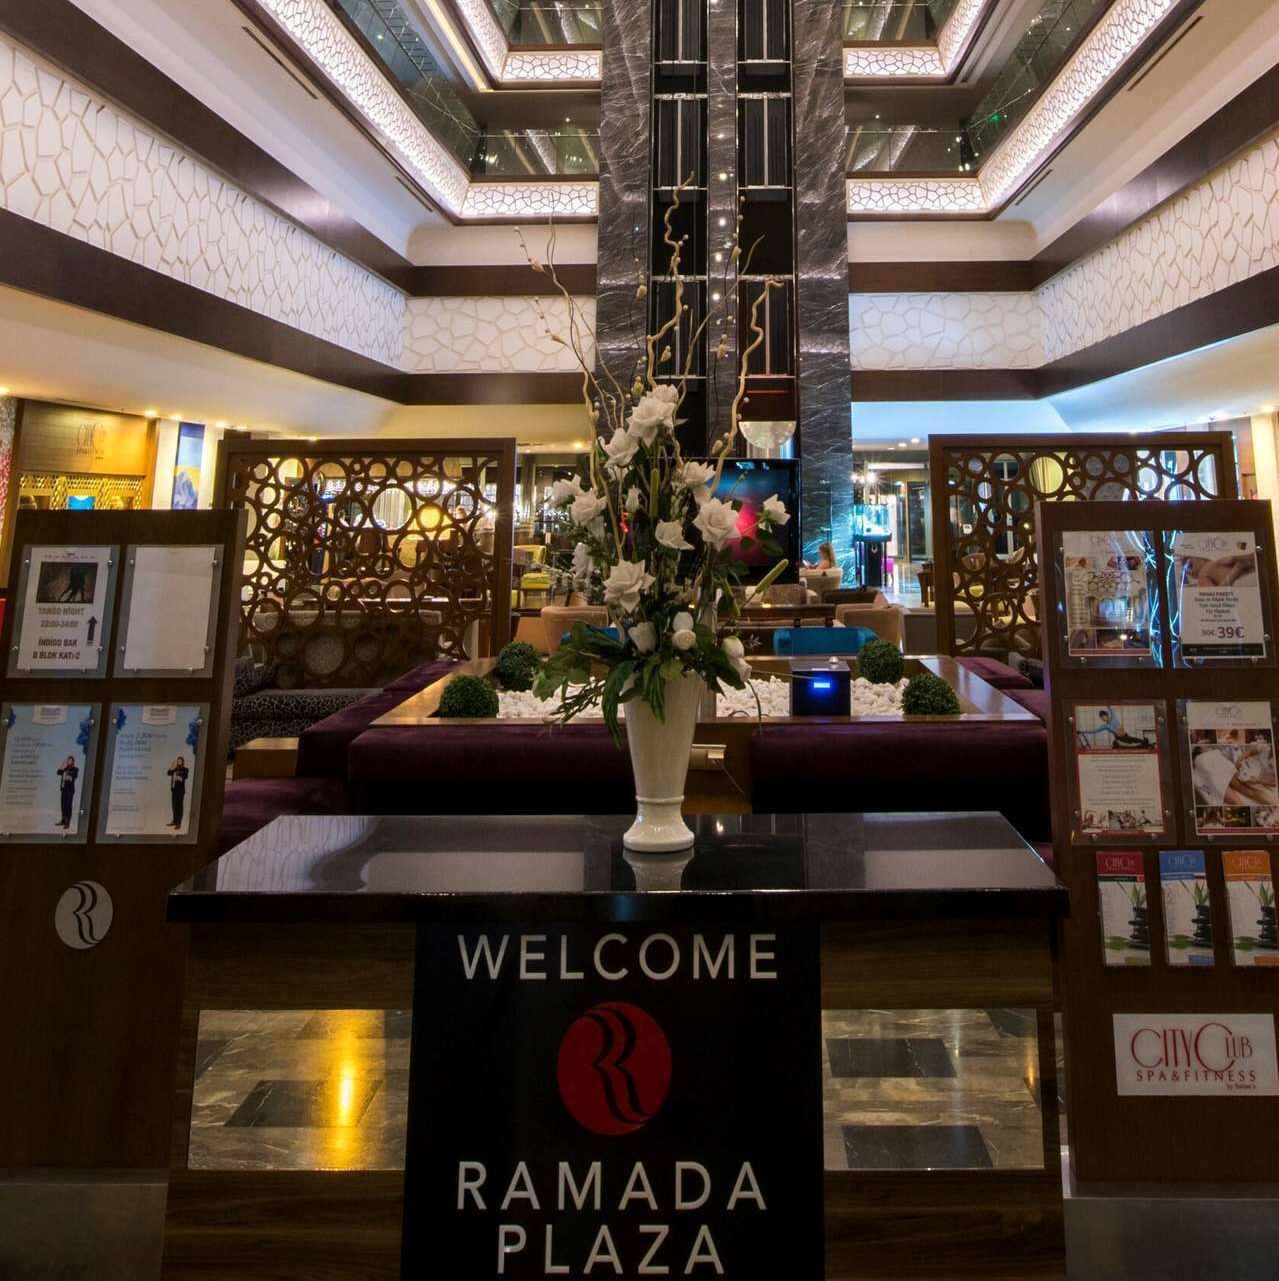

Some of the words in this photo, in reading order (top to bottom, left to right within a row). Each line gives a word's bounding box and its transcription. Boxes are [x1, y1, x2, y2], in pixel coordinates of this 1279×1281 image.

[1217, 626, 1245, 639] 39€
[63, 638, 78, 647] BAR
[39, 651, 58, 659] BLOK
[456, 932, 778, 981] WELCOME
[1136, 1071, 1257, 1082] SPA&FITNESS
[456, 1161, 768, 1211] RAMADA
[497, 1224, 725, 1275] PLAZA
